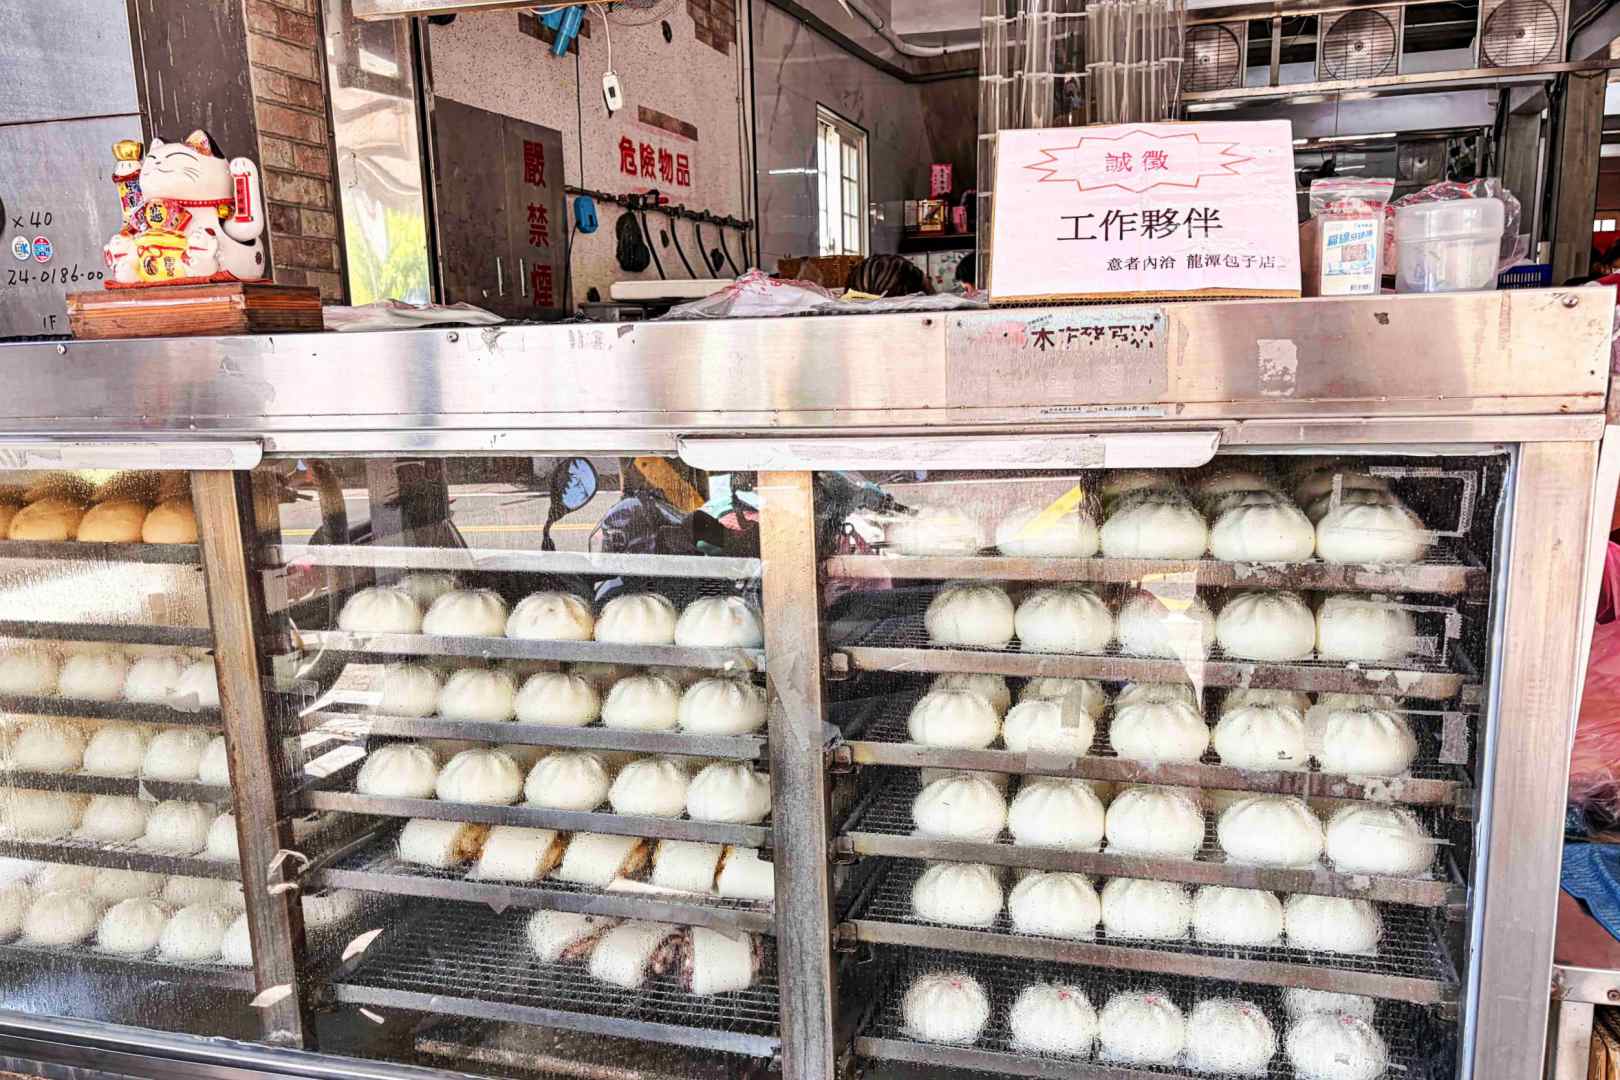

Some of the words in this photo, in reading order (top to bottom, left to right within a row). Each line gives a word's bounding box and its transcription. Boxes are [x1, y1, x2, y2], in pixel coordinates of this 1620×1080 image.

[618, 135, 691, 187] 危險物品
[1056, 207, 1224, 241] 工作夥伴
